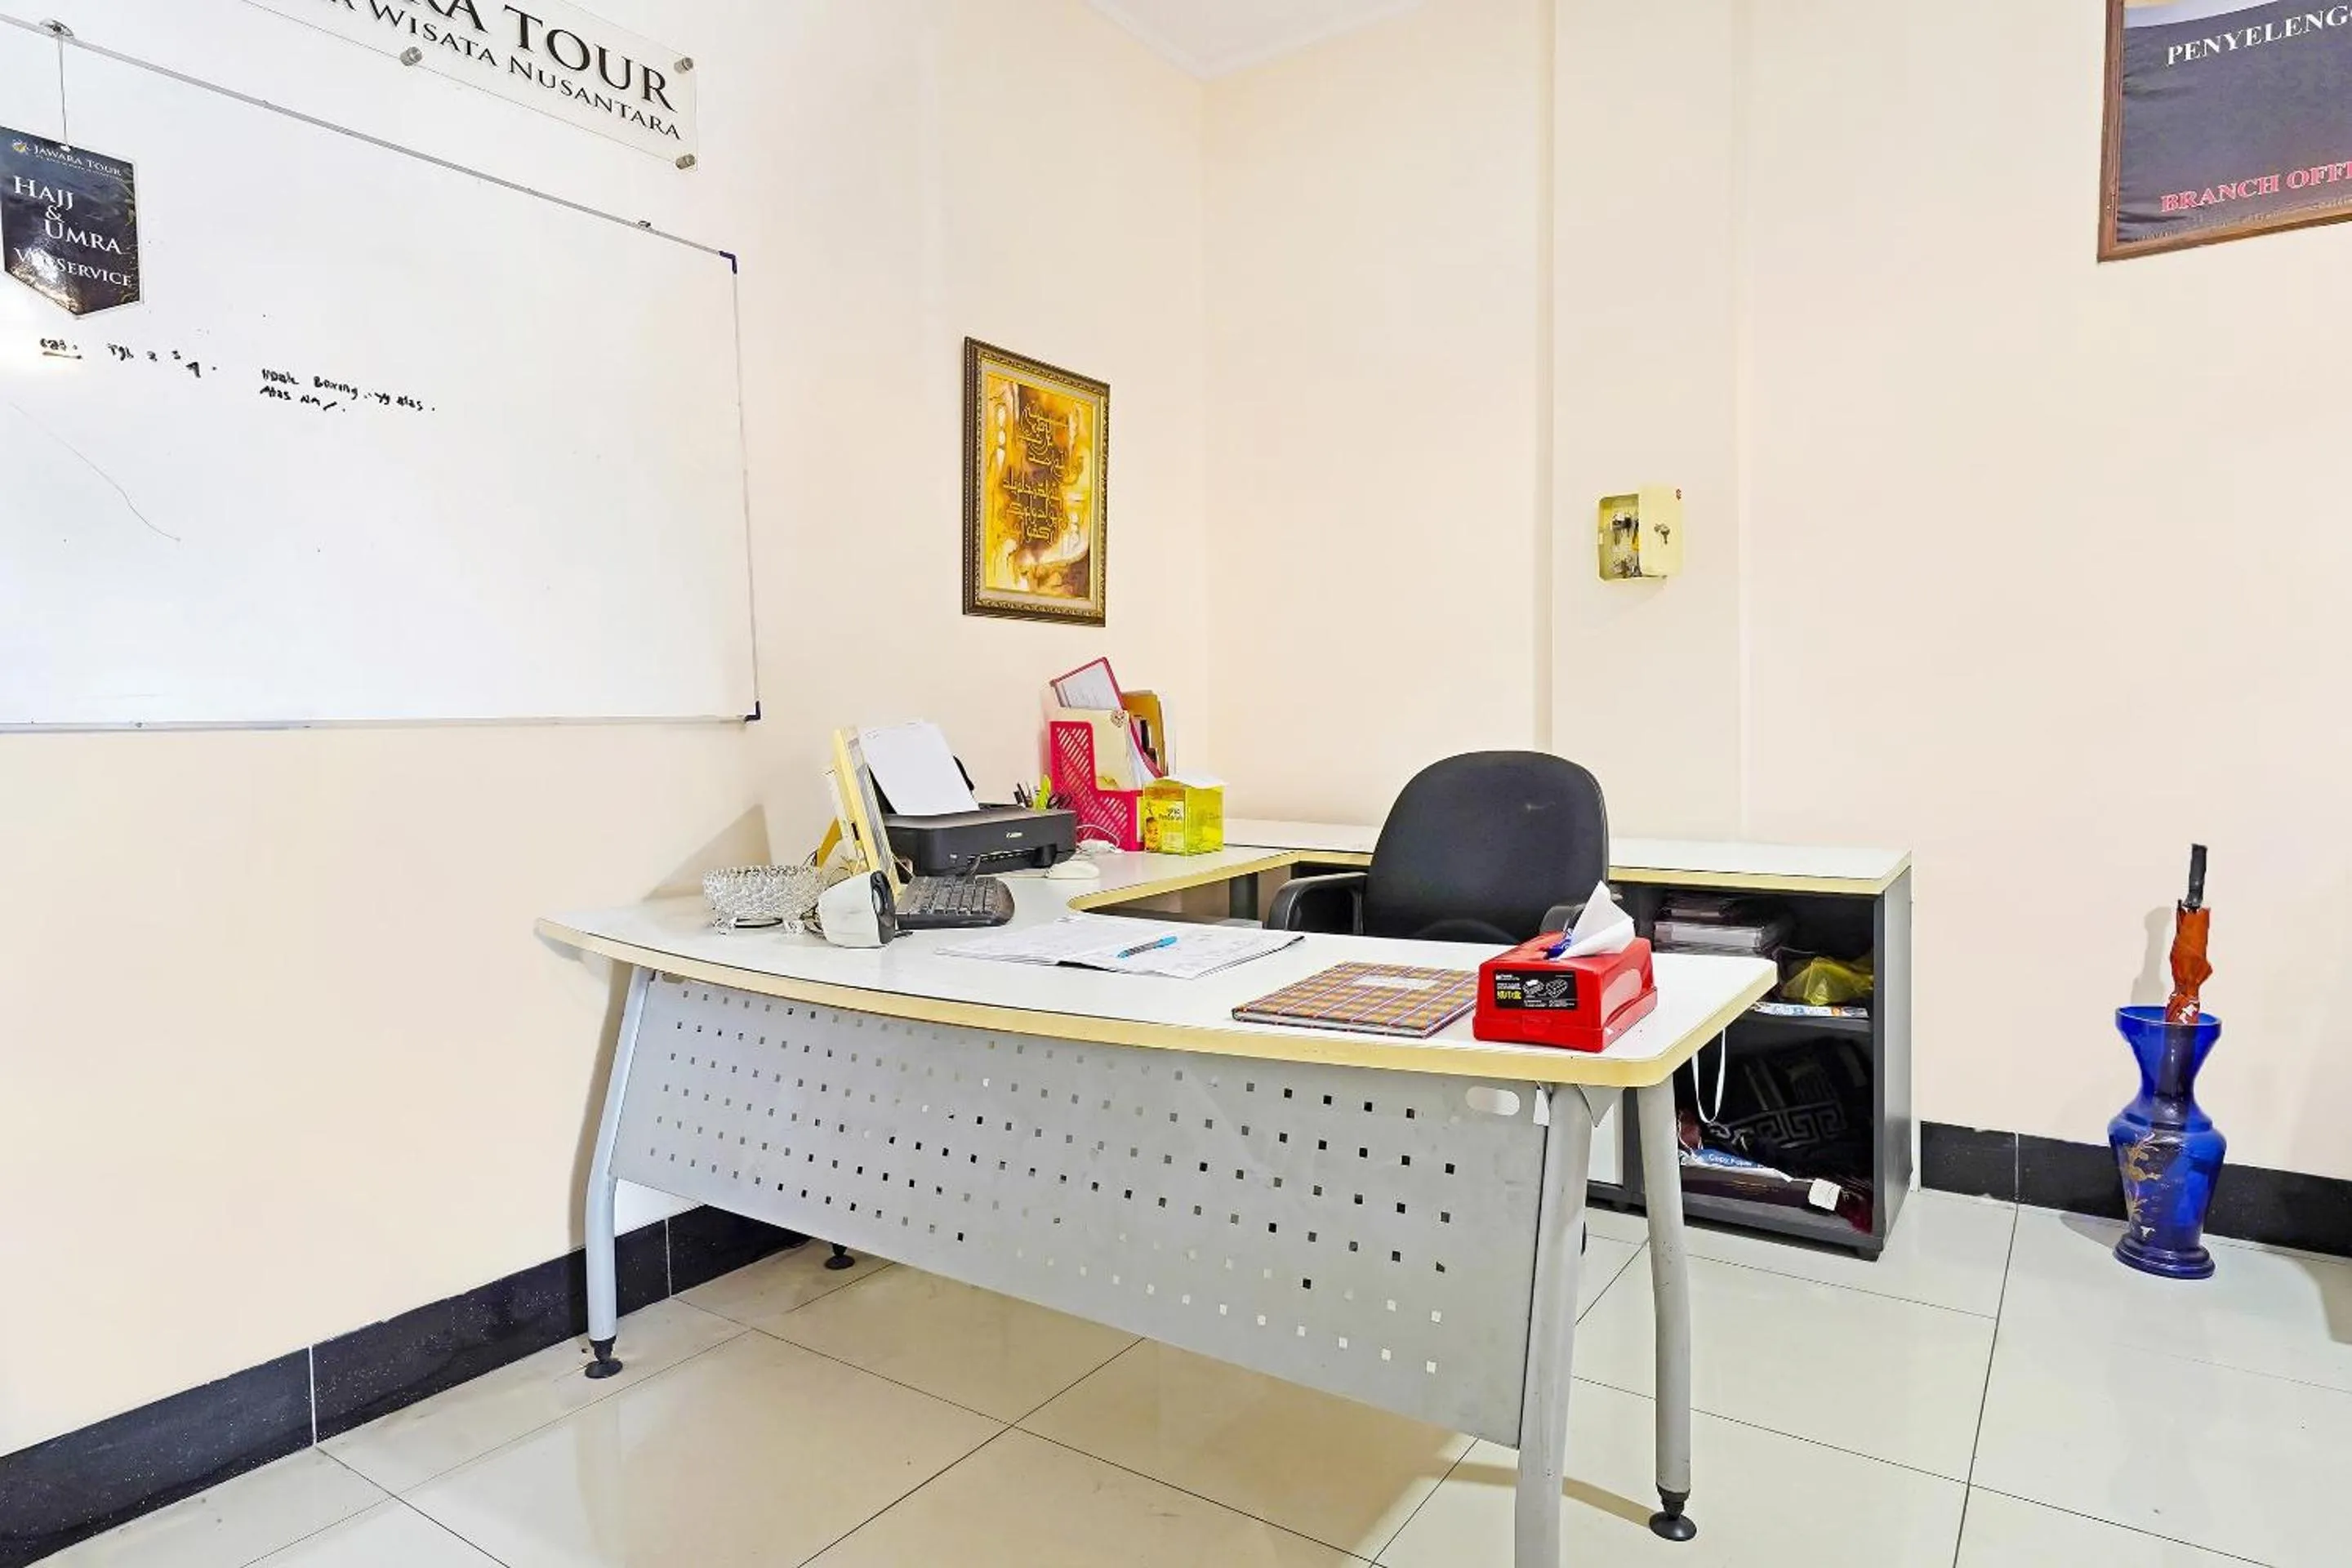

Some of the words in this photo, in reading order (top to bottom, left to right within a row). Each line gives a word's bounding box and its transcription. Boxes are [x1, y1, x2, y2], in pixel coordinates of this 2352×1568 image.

[2167, 5, 2352, 66] PENYELENG
[370, 0, 497, 67] WISATA
[509, 55, 681, 140] NUSANTARA
[504, 4, 677, 113] TOUR
[33, 145, 82, 166] JAWARA
[13, 174, 74, 211] HAJJ
[2160, 174, 2279, 212] BRANCH
[45, 204, 63, 221] &
[44, 219, 122, 255] UMRA
[56, 257, 134, 287] SERVICE
